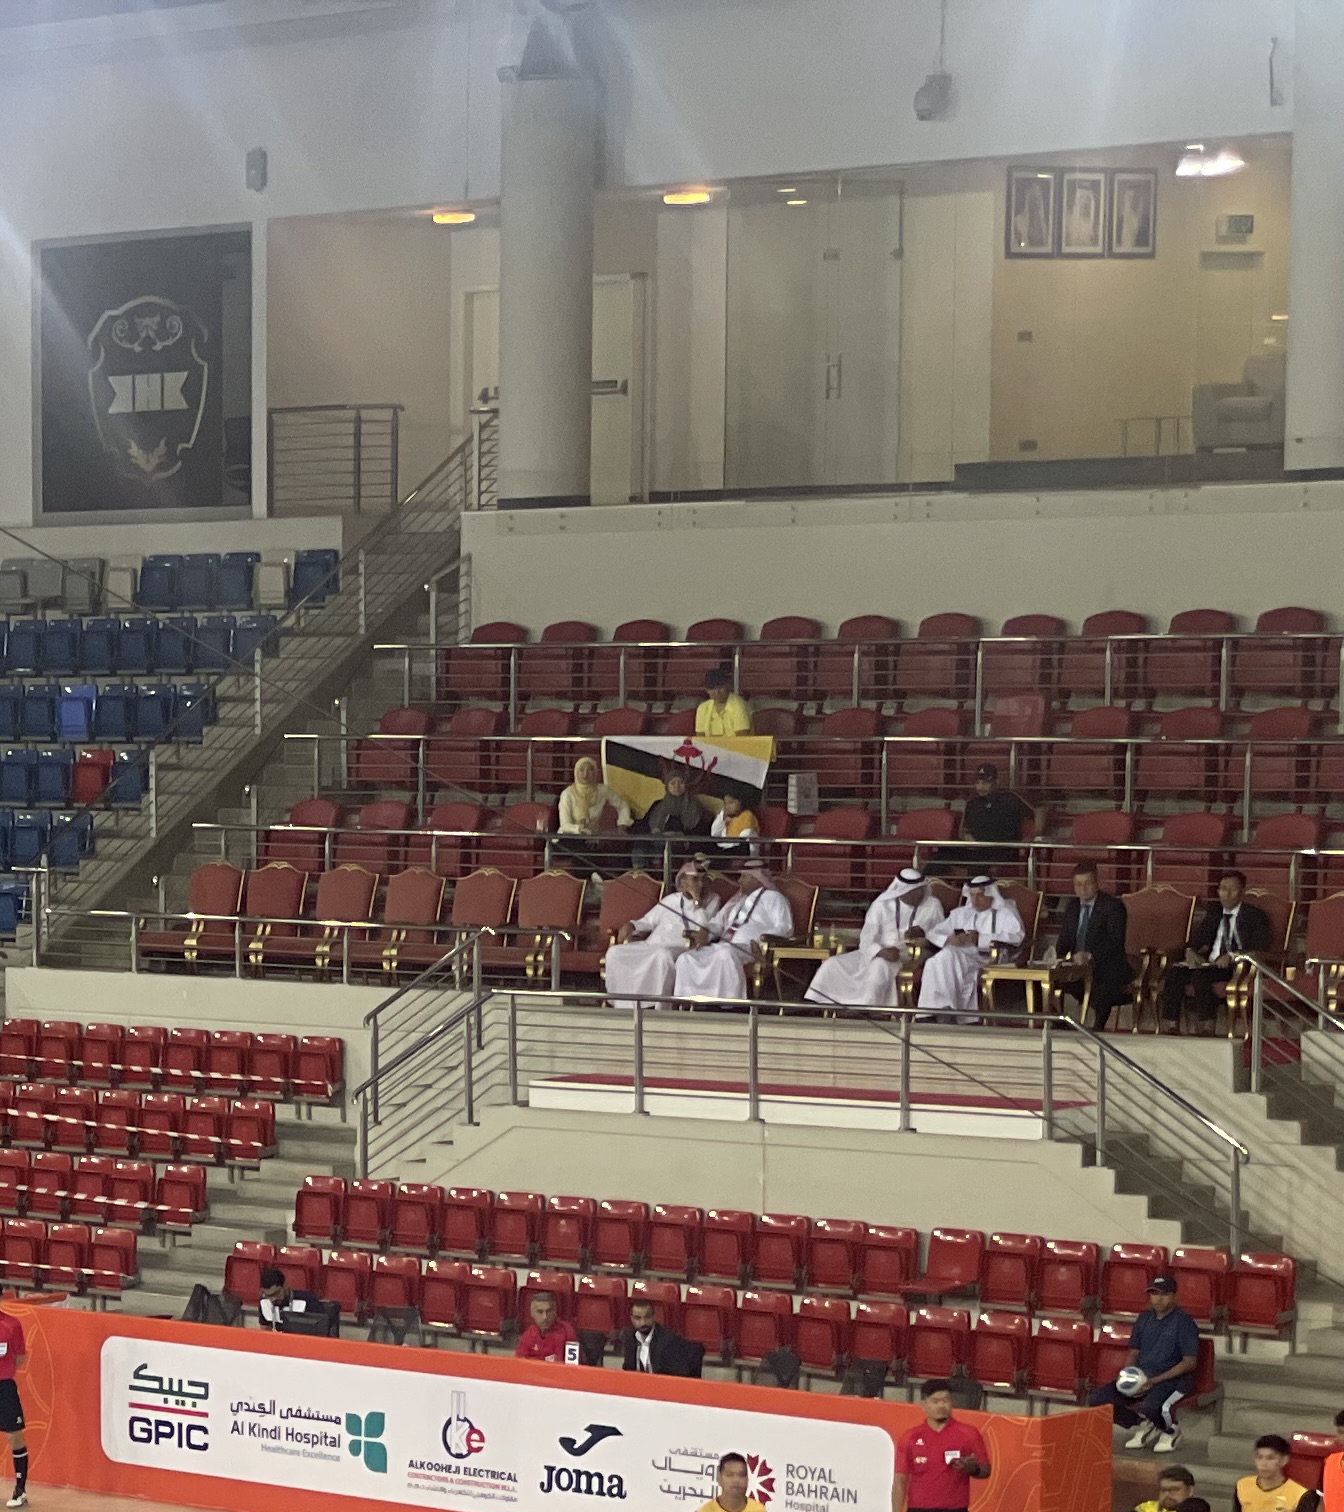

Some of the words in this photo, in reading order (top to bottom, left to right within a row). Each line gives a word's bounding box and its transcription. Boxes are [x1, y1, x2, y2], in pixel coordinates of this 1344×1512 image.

[567, 1347, 577, 1361] 5
[230, 1398, 275, 1418] الكندي
[279, 1405, 342, 1425] مستشفى
[129, 1416, 209, 1451] GPIC
[230, 1420, 245, 1436] Al
[248, 1421, 281, 1441] Kindi
[285, 1426, 341, 1448] Hospital
[261, 1443, 301, 1457] Healthcare
[463, 1466, 518, 1483] ELECTRICAL
[785, 1464, 837, 1484] ROYAL
[785, 1481, 858, 1505] BAHRAIN
